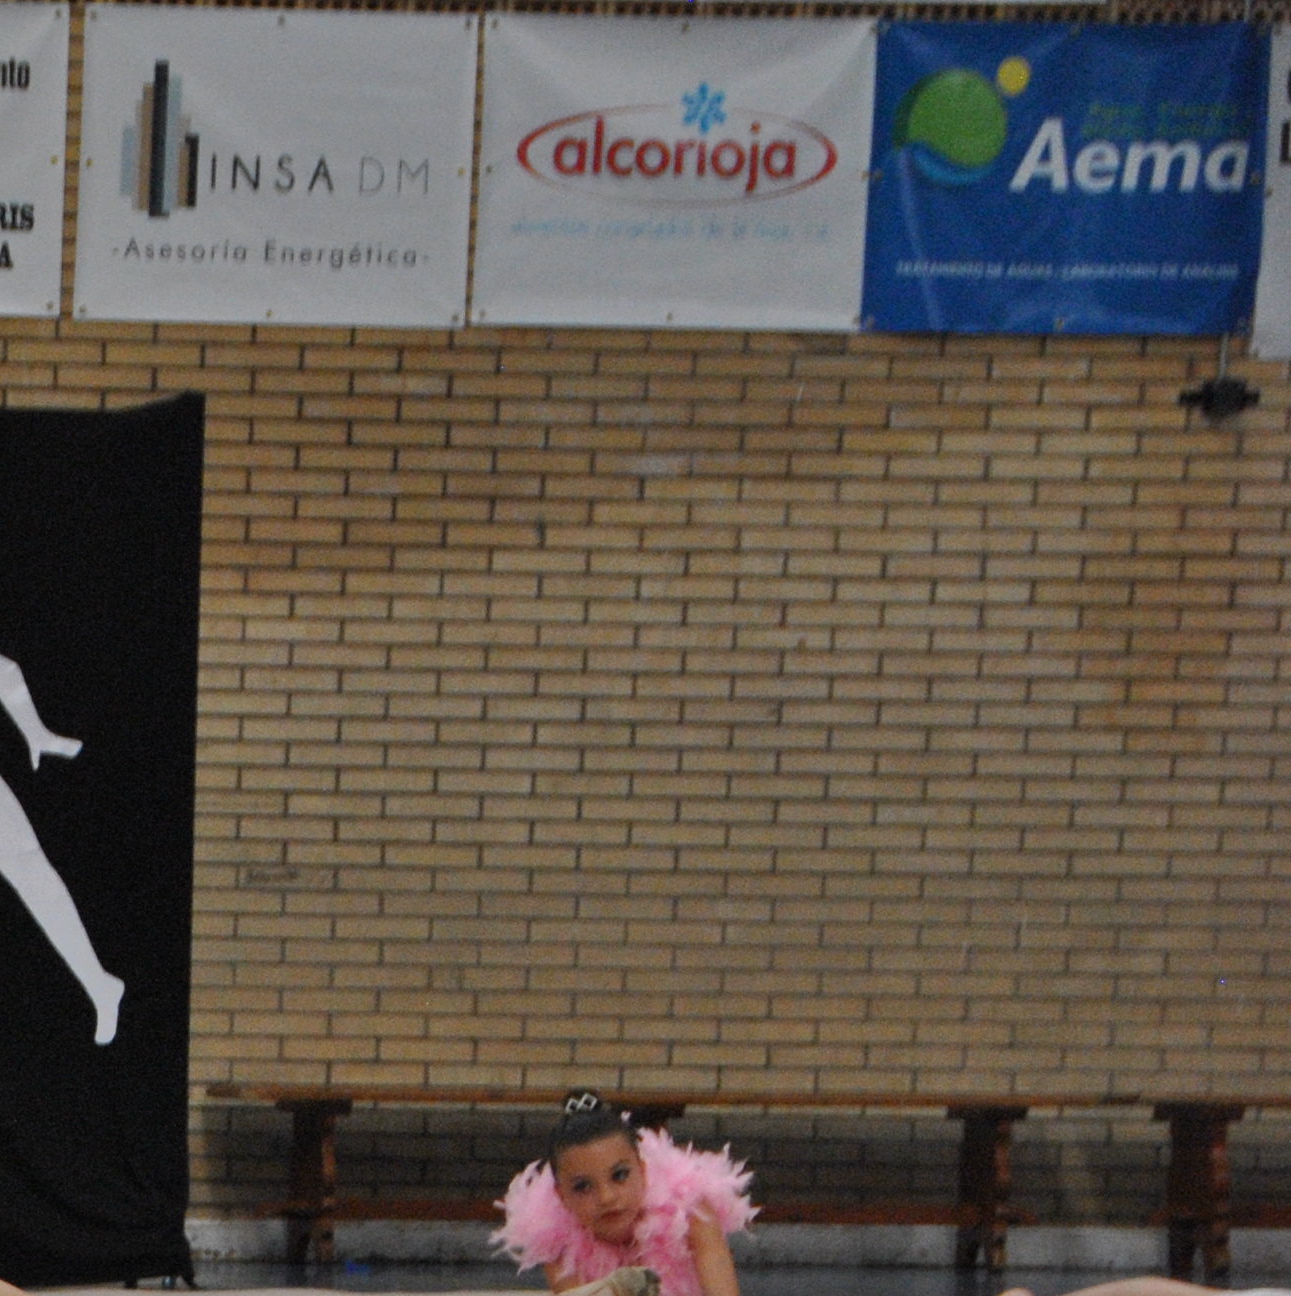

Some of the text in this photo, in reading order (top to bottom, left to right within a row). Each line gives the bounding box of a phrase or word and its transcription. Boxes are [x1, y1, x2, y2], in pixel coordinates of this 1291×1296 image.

[210, 153, 430, 194] INSA DM
[553, 114, 797, 196] alcorioja
[1009, 116, 1250, 193] Aema
